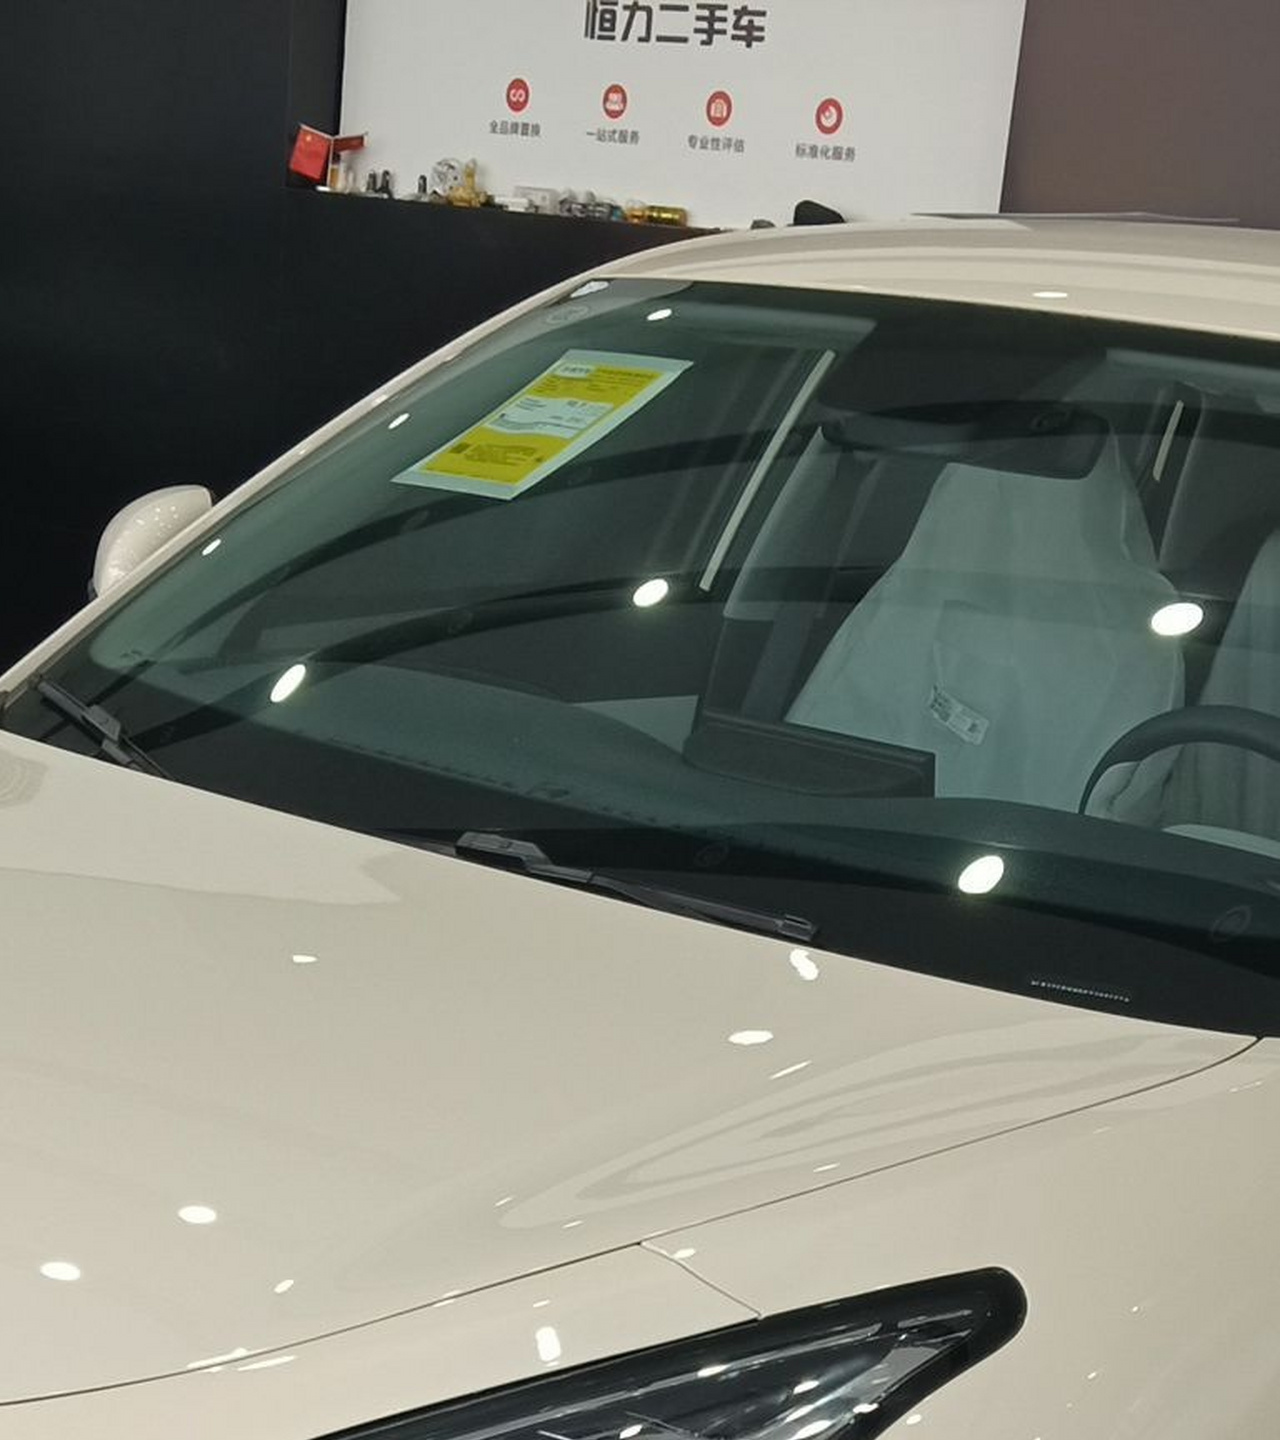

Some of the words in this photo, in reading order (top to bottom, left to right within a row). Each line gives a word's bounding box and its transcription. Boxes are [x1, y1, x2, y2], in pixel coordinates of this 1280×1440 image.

[584, 0, 767, 48] 恒力二手车
[586, 129, 640, 145] 一站式服务
[688, 134, 744, 152] 专业性评估
[795, 143, 855, 162] 标准化服务
